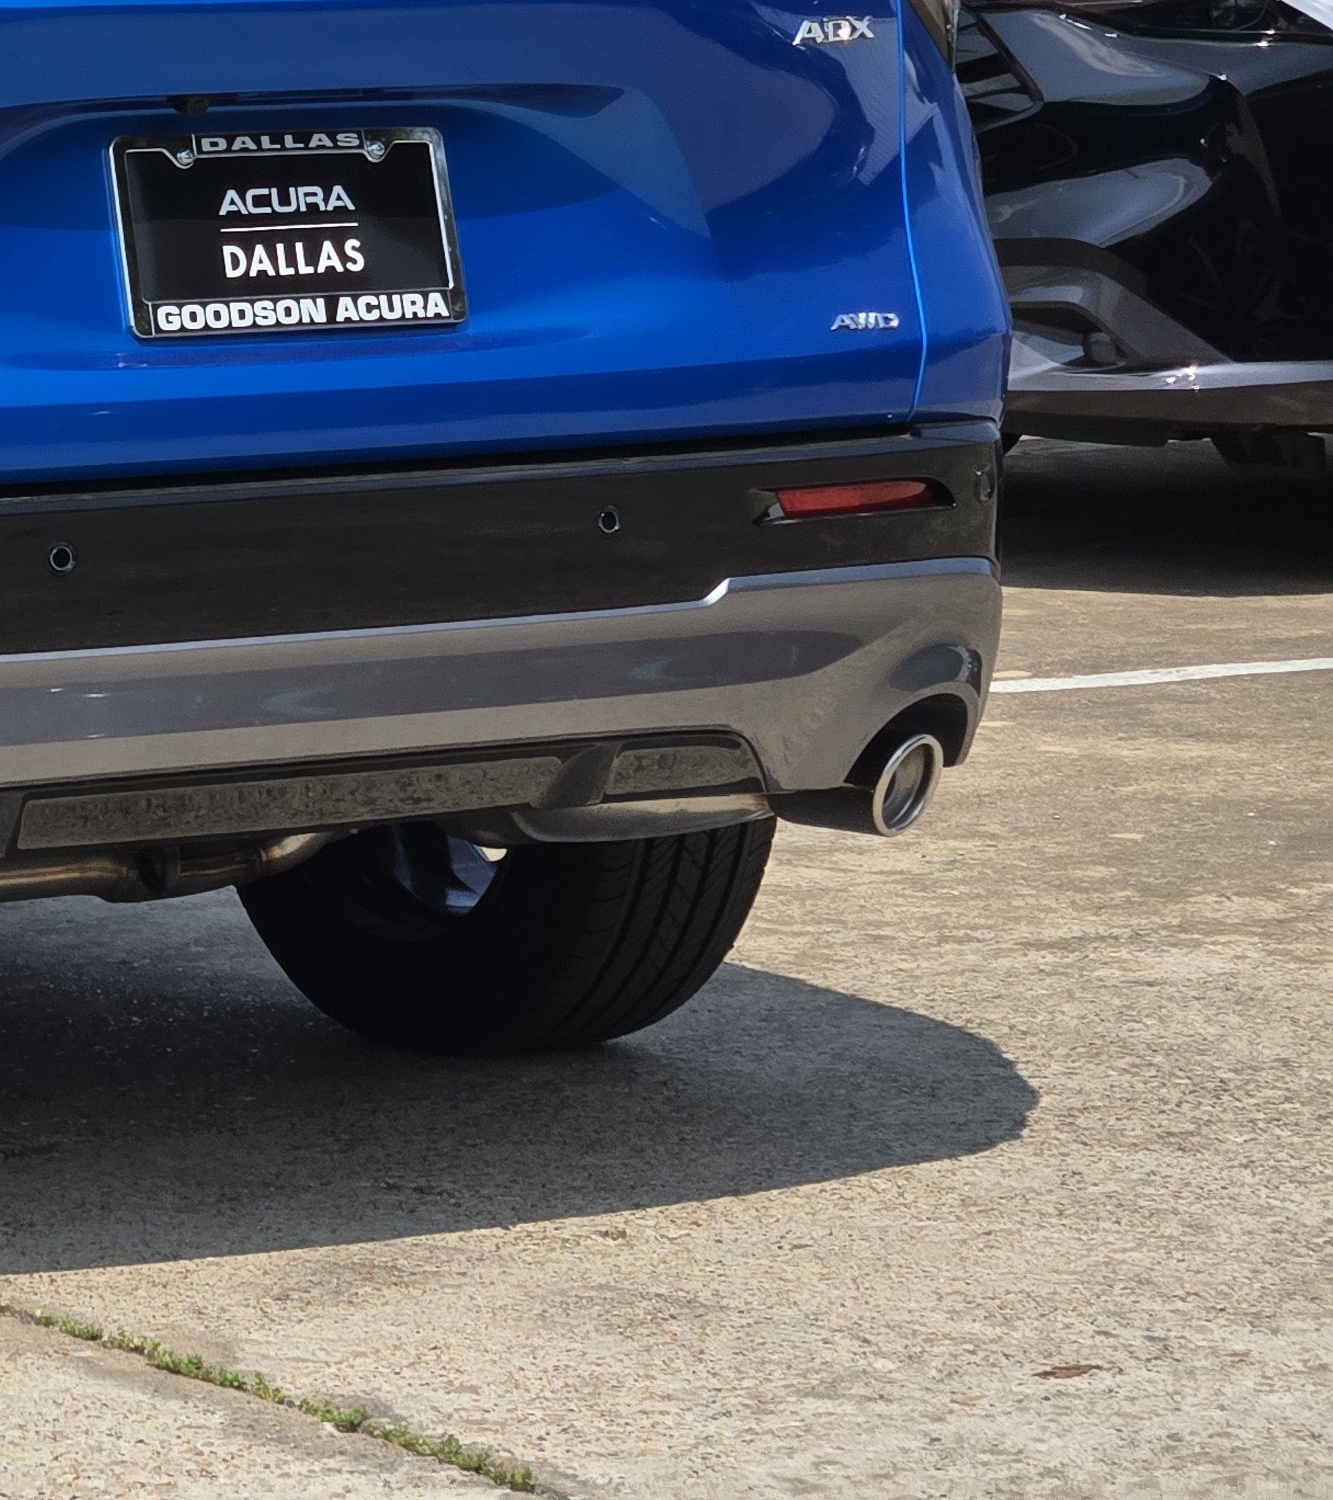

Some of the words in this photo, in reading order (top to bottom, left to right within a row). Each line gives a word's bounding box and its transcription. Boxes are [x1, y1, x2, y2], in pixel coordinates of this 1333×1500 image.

[792, 15, 875, 46] ADX
[200, 133, 361, 153] DALLAS
[218, 184, 356, 216] ACURA
[221, 238, 366, 279] DALLAS
[156, 299, 327, 332] GOODSON
[335, 292, 450, 323] ACURA
[830, 311, 900, 331] AWD
